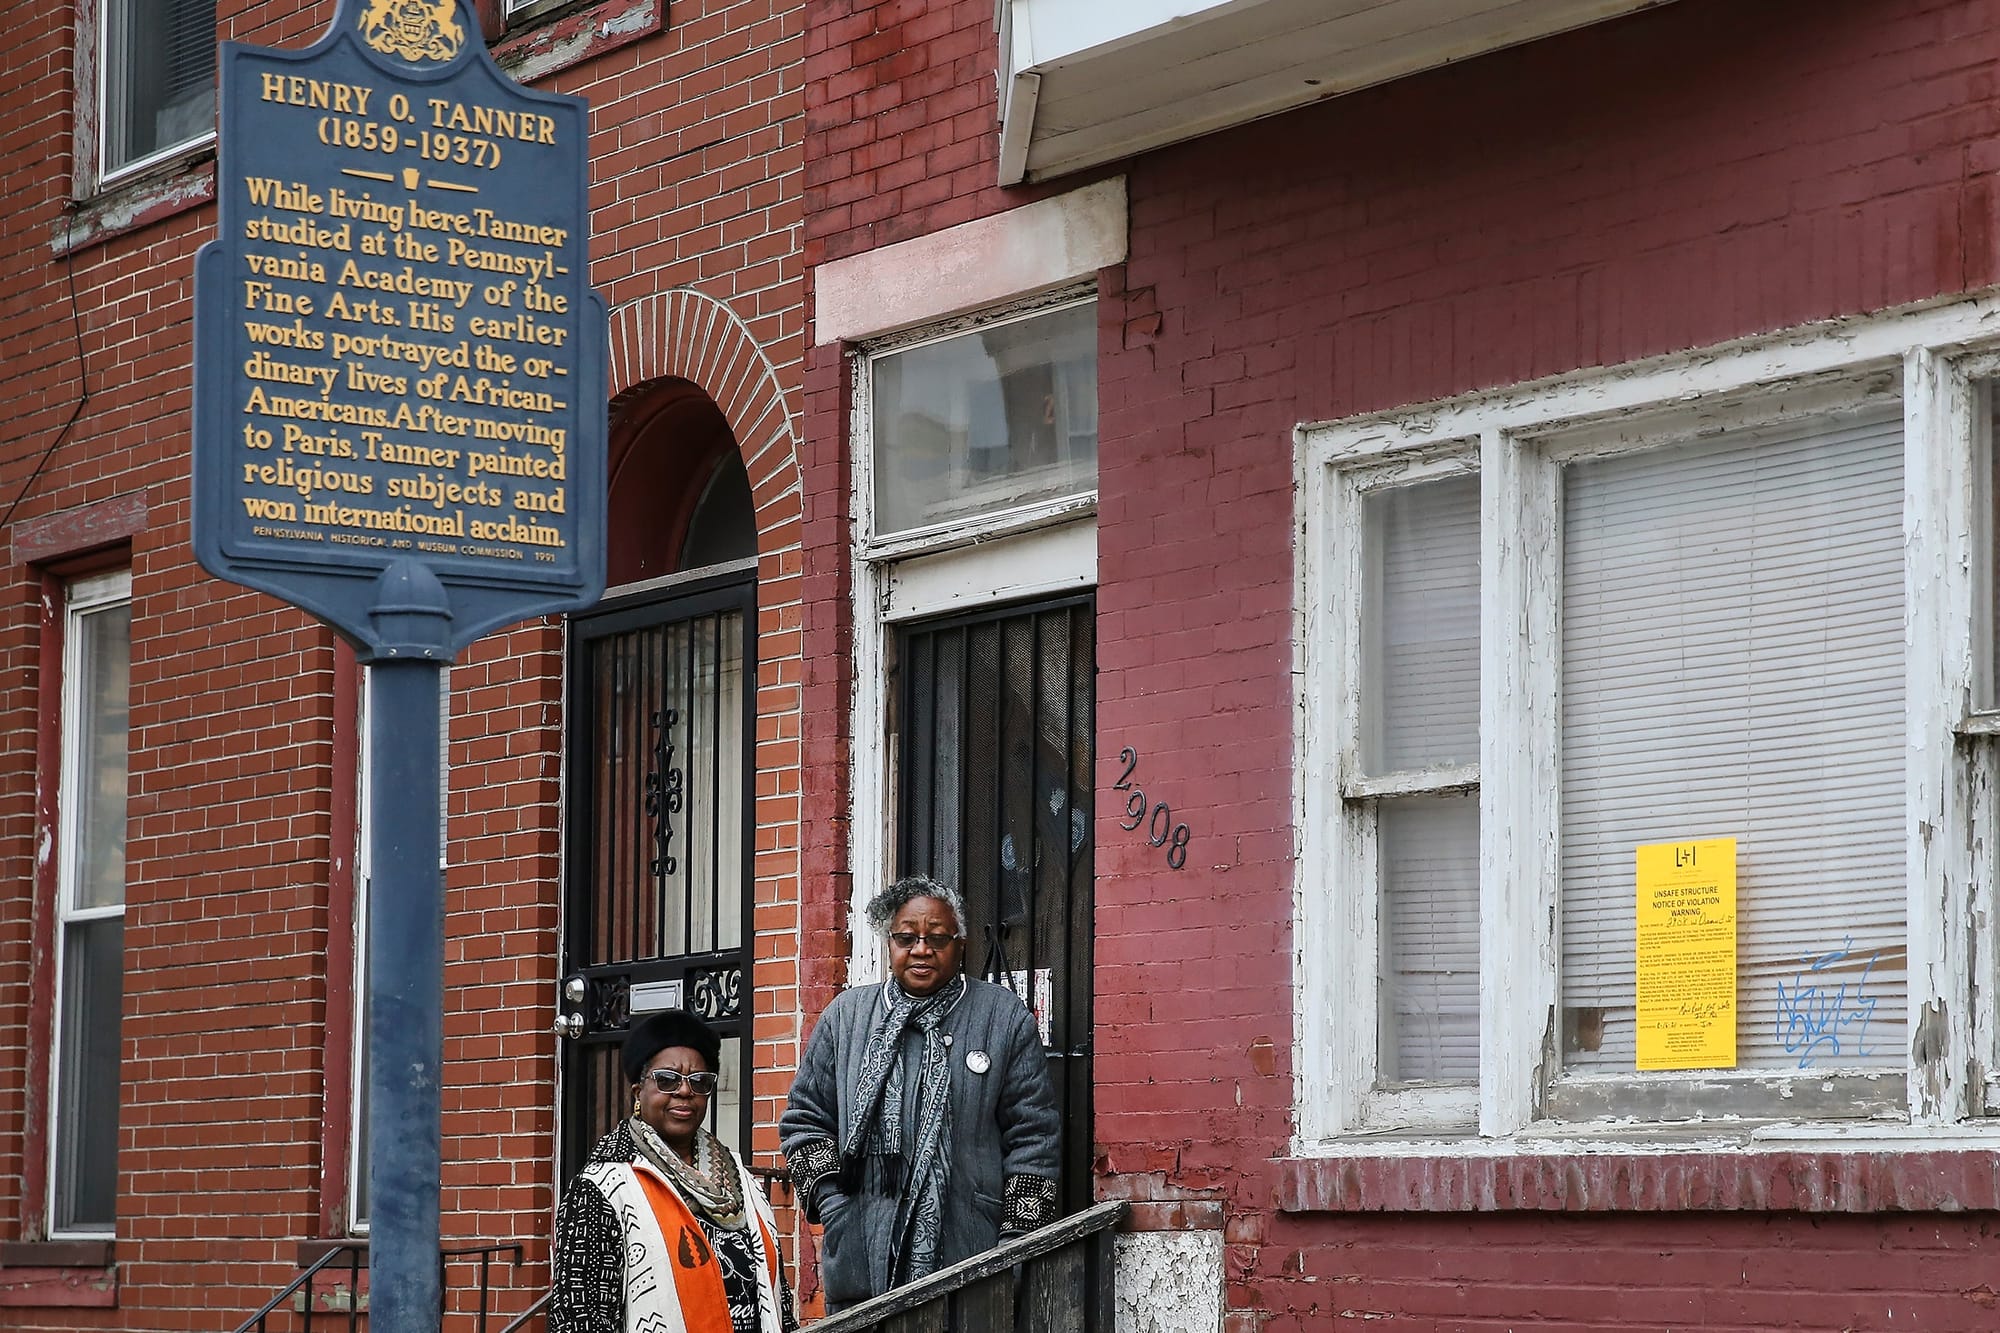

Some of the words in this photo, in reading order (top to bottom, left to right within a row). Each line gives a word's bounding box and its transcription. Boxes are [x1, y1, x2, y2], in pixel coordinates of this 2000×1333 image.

[263, 73, 371, 115] HENRY
[389, 94, 416, 122] O.
[429, 99, 555, 144] TANNER
[319, 118, 501, 168] (1859-1937)
[246, 177, 323, 213] While
[330, 189, 404, 231] living
[246, 217, 351, 250] studied
[361, 236, 386, 255] at
[395, 232, 439, 262] the
[449, 239, 568, 284] Pennsyl-
[246, 253, 325, 282] vania
[338, 259, 473, 307] Academy
[485, 283, 516, 305] of
[524, 284, 567, 313] the
[245, 282, 313, 314] Fine
[325, 292, 400, 326] Arts.
[410, 301, 455, 332] His
[470, 315, 567, 346] earlier
[245, 320, 324, 350] works
[332, 331, 470, 371] portrayed
[475, 341, 516, 373] the
[524, 357, 567, 377] or-
[245, 353, 338, 395] dinary
[348, 362, 408, 396] lives
[416, 373, 448, 399] of
[449, 377, 566, 412] African-
[245, 424, 272, 449] to
[284, 425, 357, 458] Paris,
[361, 432, 460, 467] Tanner
[468, 446, 566, 479] painted
[475, 414, 566, 453] moving
[245, 458, 373, 494] religious
[388, 472, 501, 509] subjects
[515, 488, 565, 513] and
[245, 496, 295, 521] won
[305, 496, 464, 536] international
[471, 512, 565, 547] acclaim.
[253, 526, 324, 541] PENNSYLVANIA
[392, 539, 412, 549] AND
[417, 541, 456, 553] MUSEUM
[461, 545, 523, 559] COMMISSION
[535, 552, 555, 562] 1991
[1113, 745, 1190, 869] 2908
[1652, 901, 1676, 909] NOTICE
[1686, 897, 1719, 906] VIOLATION
[1654, 889, 1679, 898] UNSAFE
[1680, 886, 1718, 896] STRUCTURE
[1671, 908, 1701, 916] WARNING
